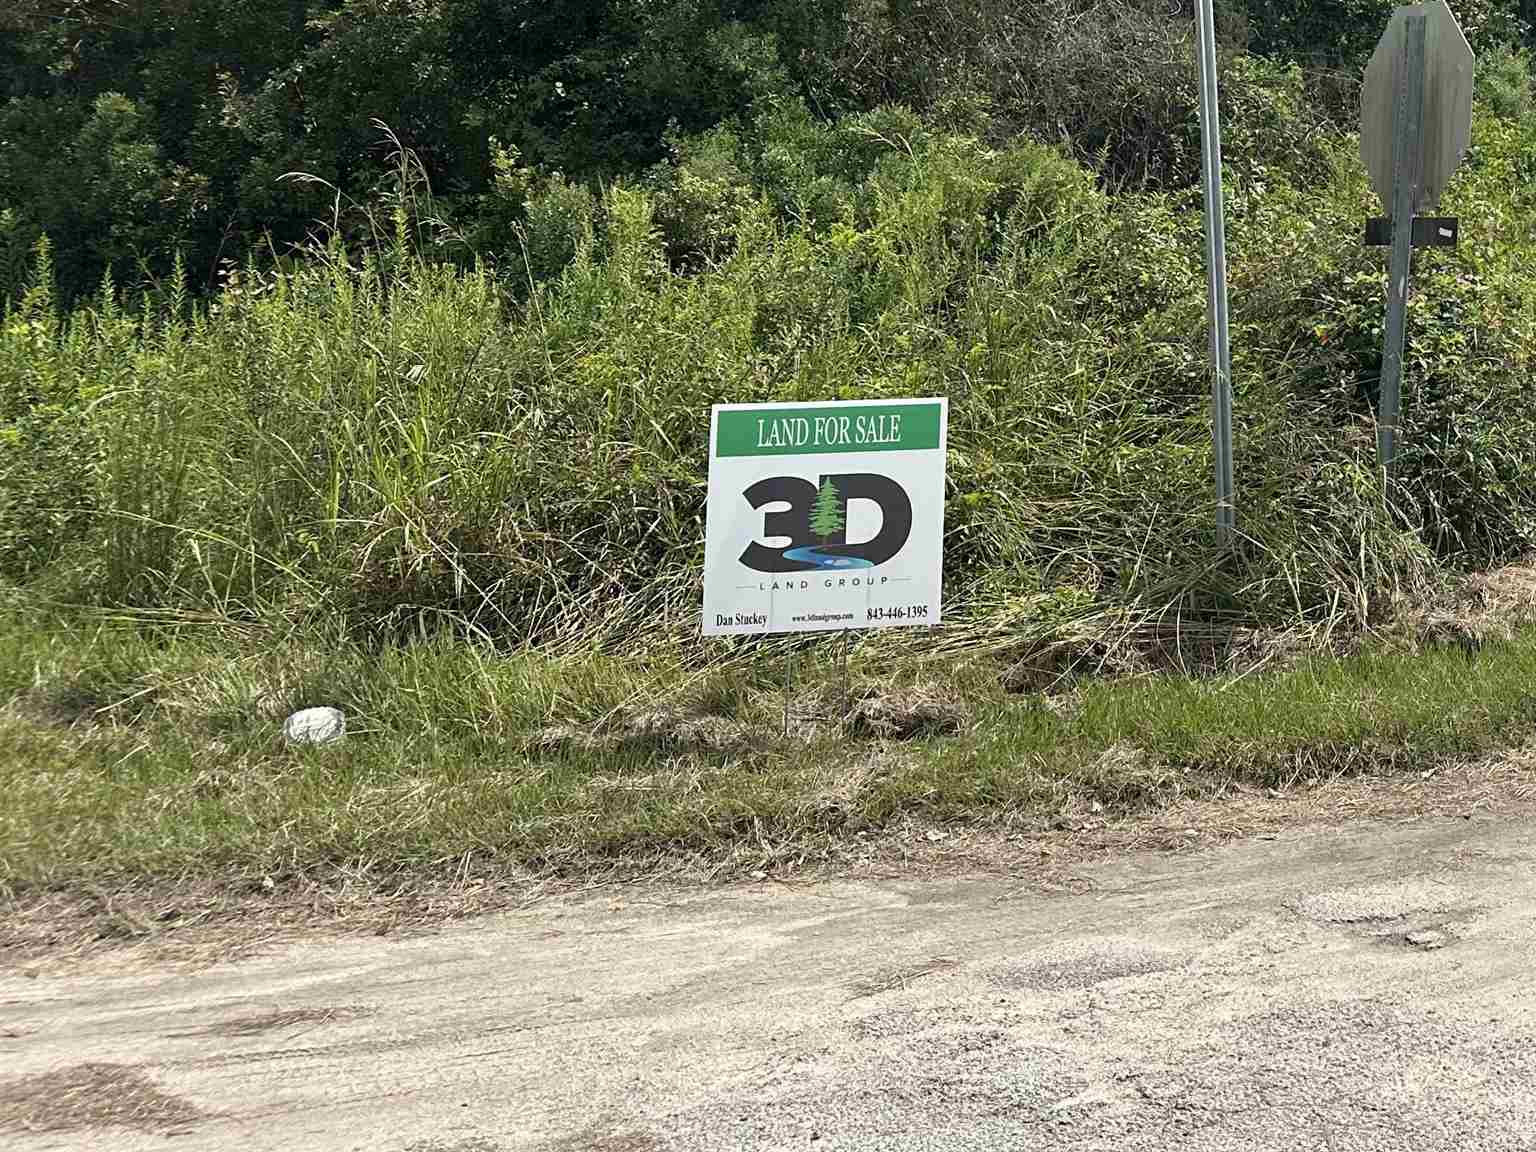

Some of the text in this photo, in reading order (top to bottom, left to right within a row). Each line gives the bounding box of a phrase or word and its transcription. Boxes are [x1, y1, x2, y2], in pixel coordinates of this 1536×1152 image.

[757, 414, 901, 447] LAND FOR SALE
[738, 473, 913, 573] 3D
[760, 576, 889, 591] LAND GROUP
[716, 612, 768, 626] Dan Stuckey
[866, 605, 928, 620] 843-446-1395
